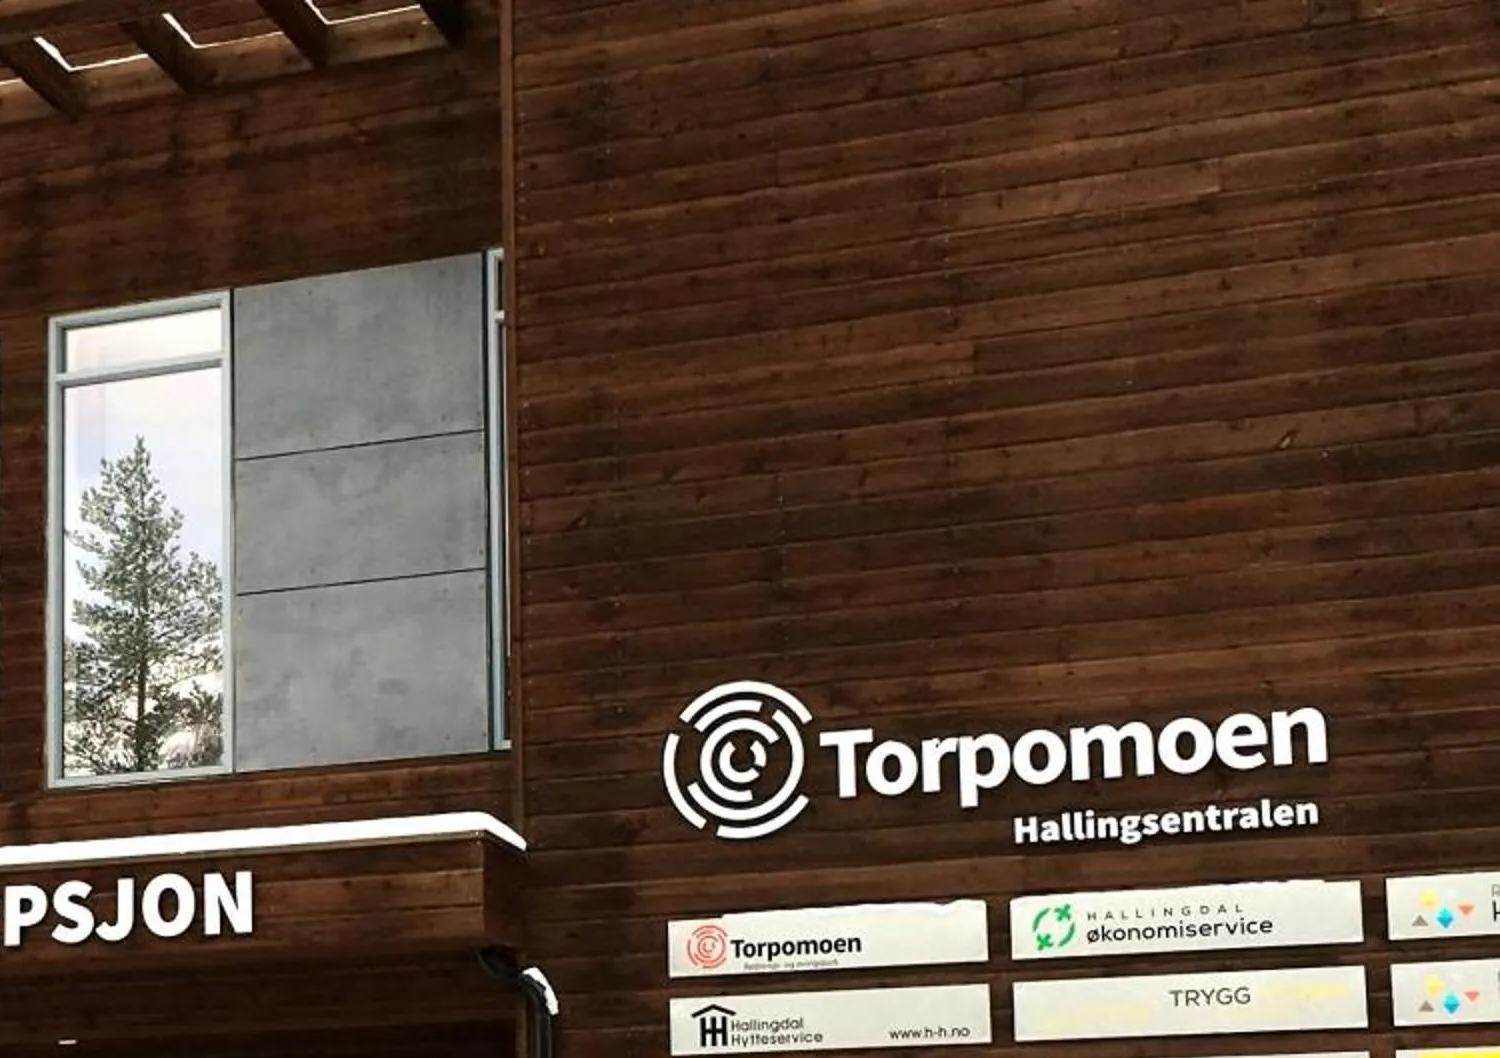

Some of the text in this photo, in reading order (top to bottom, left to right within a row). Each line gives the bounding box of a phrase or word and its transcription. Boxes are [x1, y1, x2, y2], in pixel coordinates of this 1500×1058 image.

[820, 706, 1328, 808] Torpomoen
[1012, 799, 1320, 845] Hallingsentralen
[1087, 904, 1243, 921] HALLINGDAL
[1086, 917, 1273, 944] økonomiservice
[731, 936, 862, 962] Torpomoen
[1169, 987, 1251, 1007] TRYGG
[731, 1017, 803, 1033] Hallingdal
